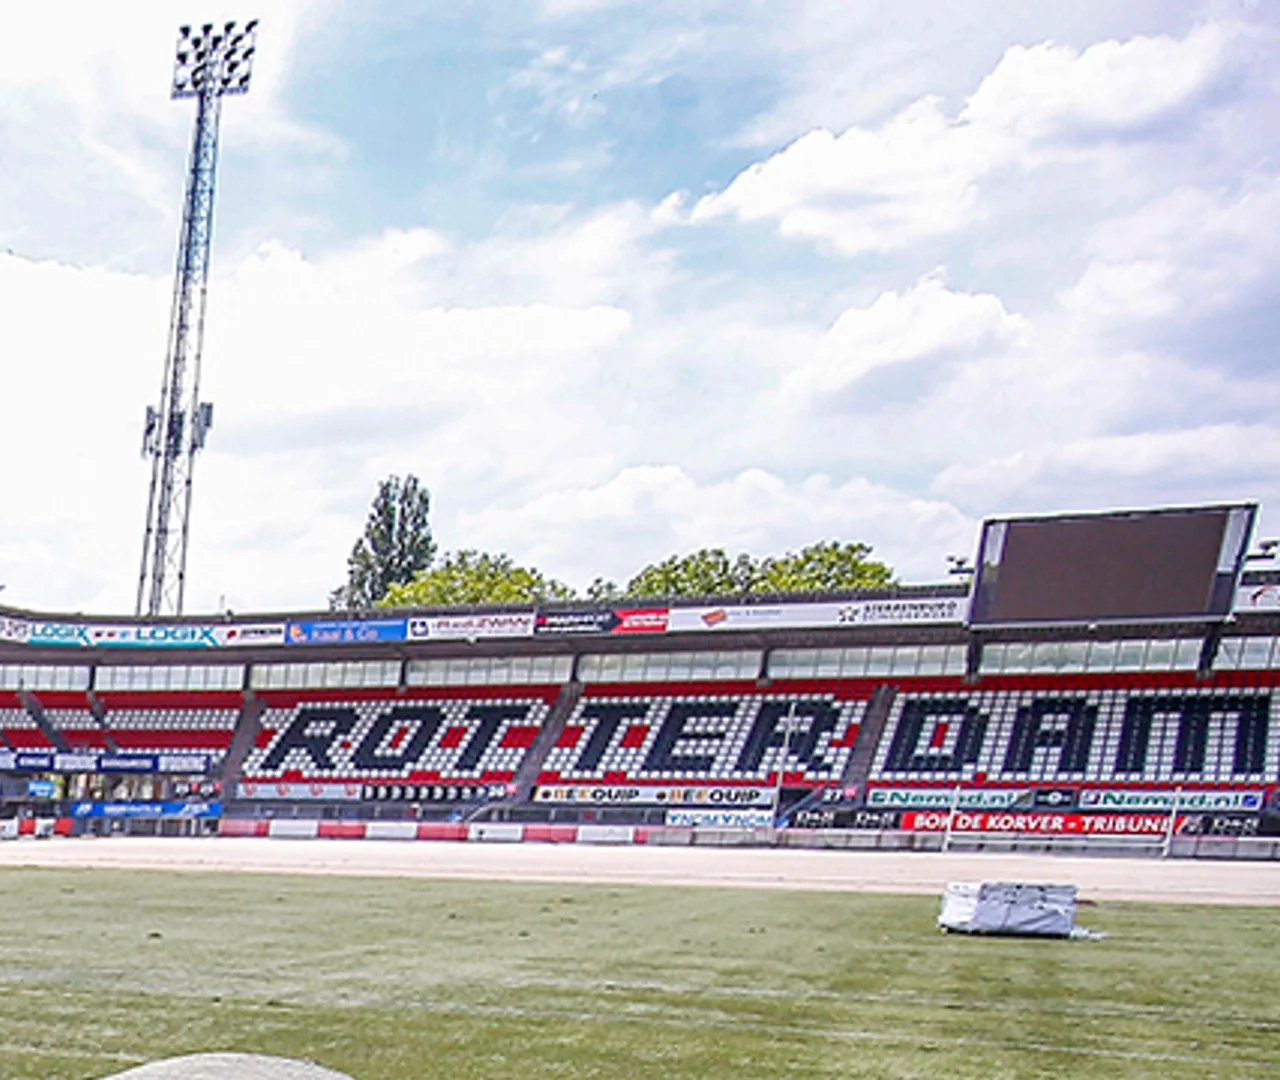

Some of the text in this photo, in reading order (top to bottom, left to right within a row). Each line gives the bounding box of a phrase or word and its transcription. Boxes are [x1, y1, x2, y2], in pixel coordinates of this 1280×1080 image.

[135, 626, 220, 646] LOGIX
[956, 814, 981, 830] DE
[986, 815, 1063, 831] KORVER
